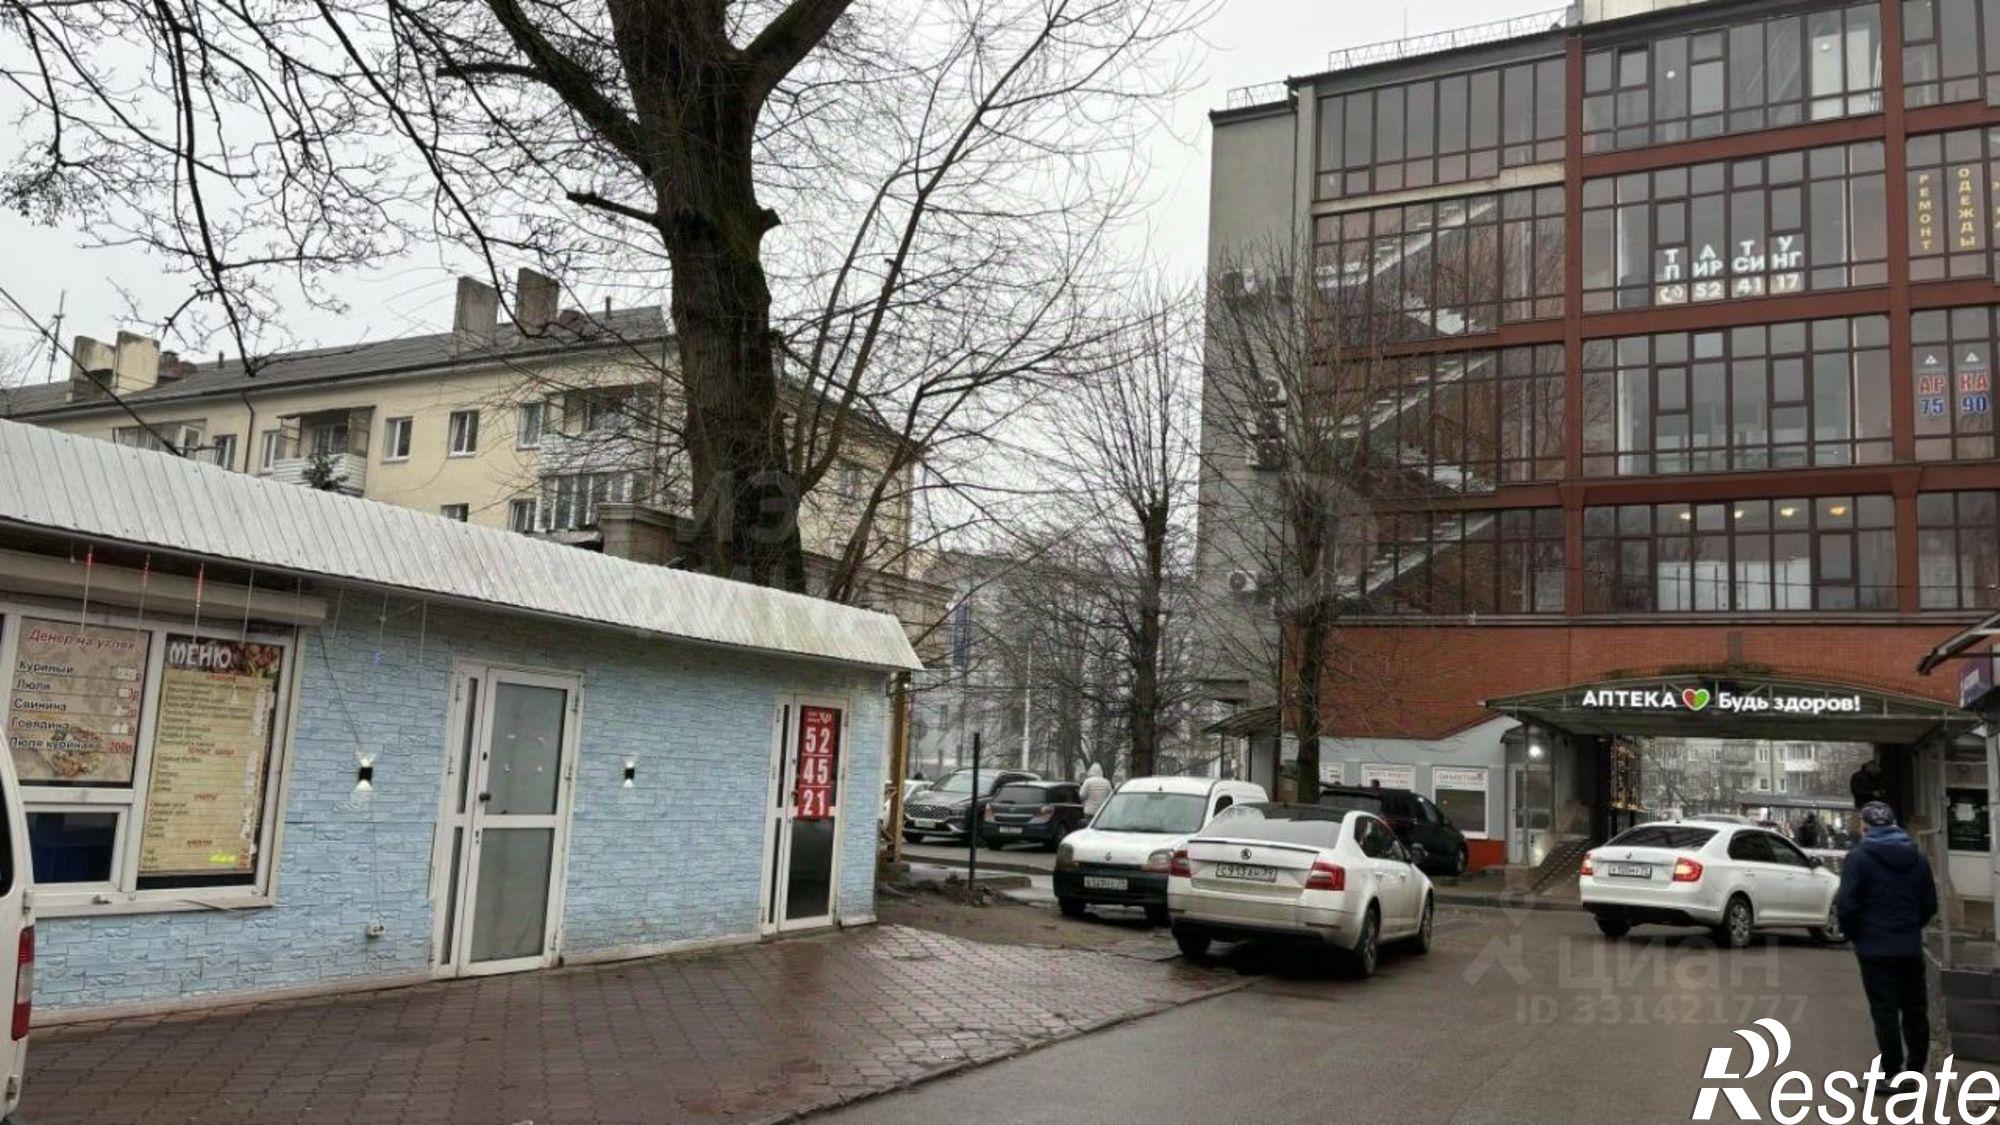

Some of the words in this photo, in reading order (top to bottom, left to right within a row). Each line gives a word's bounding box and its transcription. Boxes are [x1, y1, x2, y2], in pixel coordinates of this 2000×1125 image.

[1919, 174, 1932, 250] РЕМОНТ
[1957, 168, 1975, 247] ОДЕЖДЫ
[1664, 251, 1802, 281] ПИРСИНГ
[1695, 282, 1722, 299] 52
[1736, 277, 1762, 295] 41
[1775, 274, 1800, 290] 17
[1920, 397, 1944, 415] 75
[1961, 395, 1987, 413] 90
[169, 642, 231, 669] МЕНЮ
[1582, 690, 1676, 708] АПТЕКА
[1718, 692, 1768, 713] Будь
[1773, 695, 1861, 714] здоров!
[803, 758, 829, 785] 45
[803, 789, 826, 816] 21
